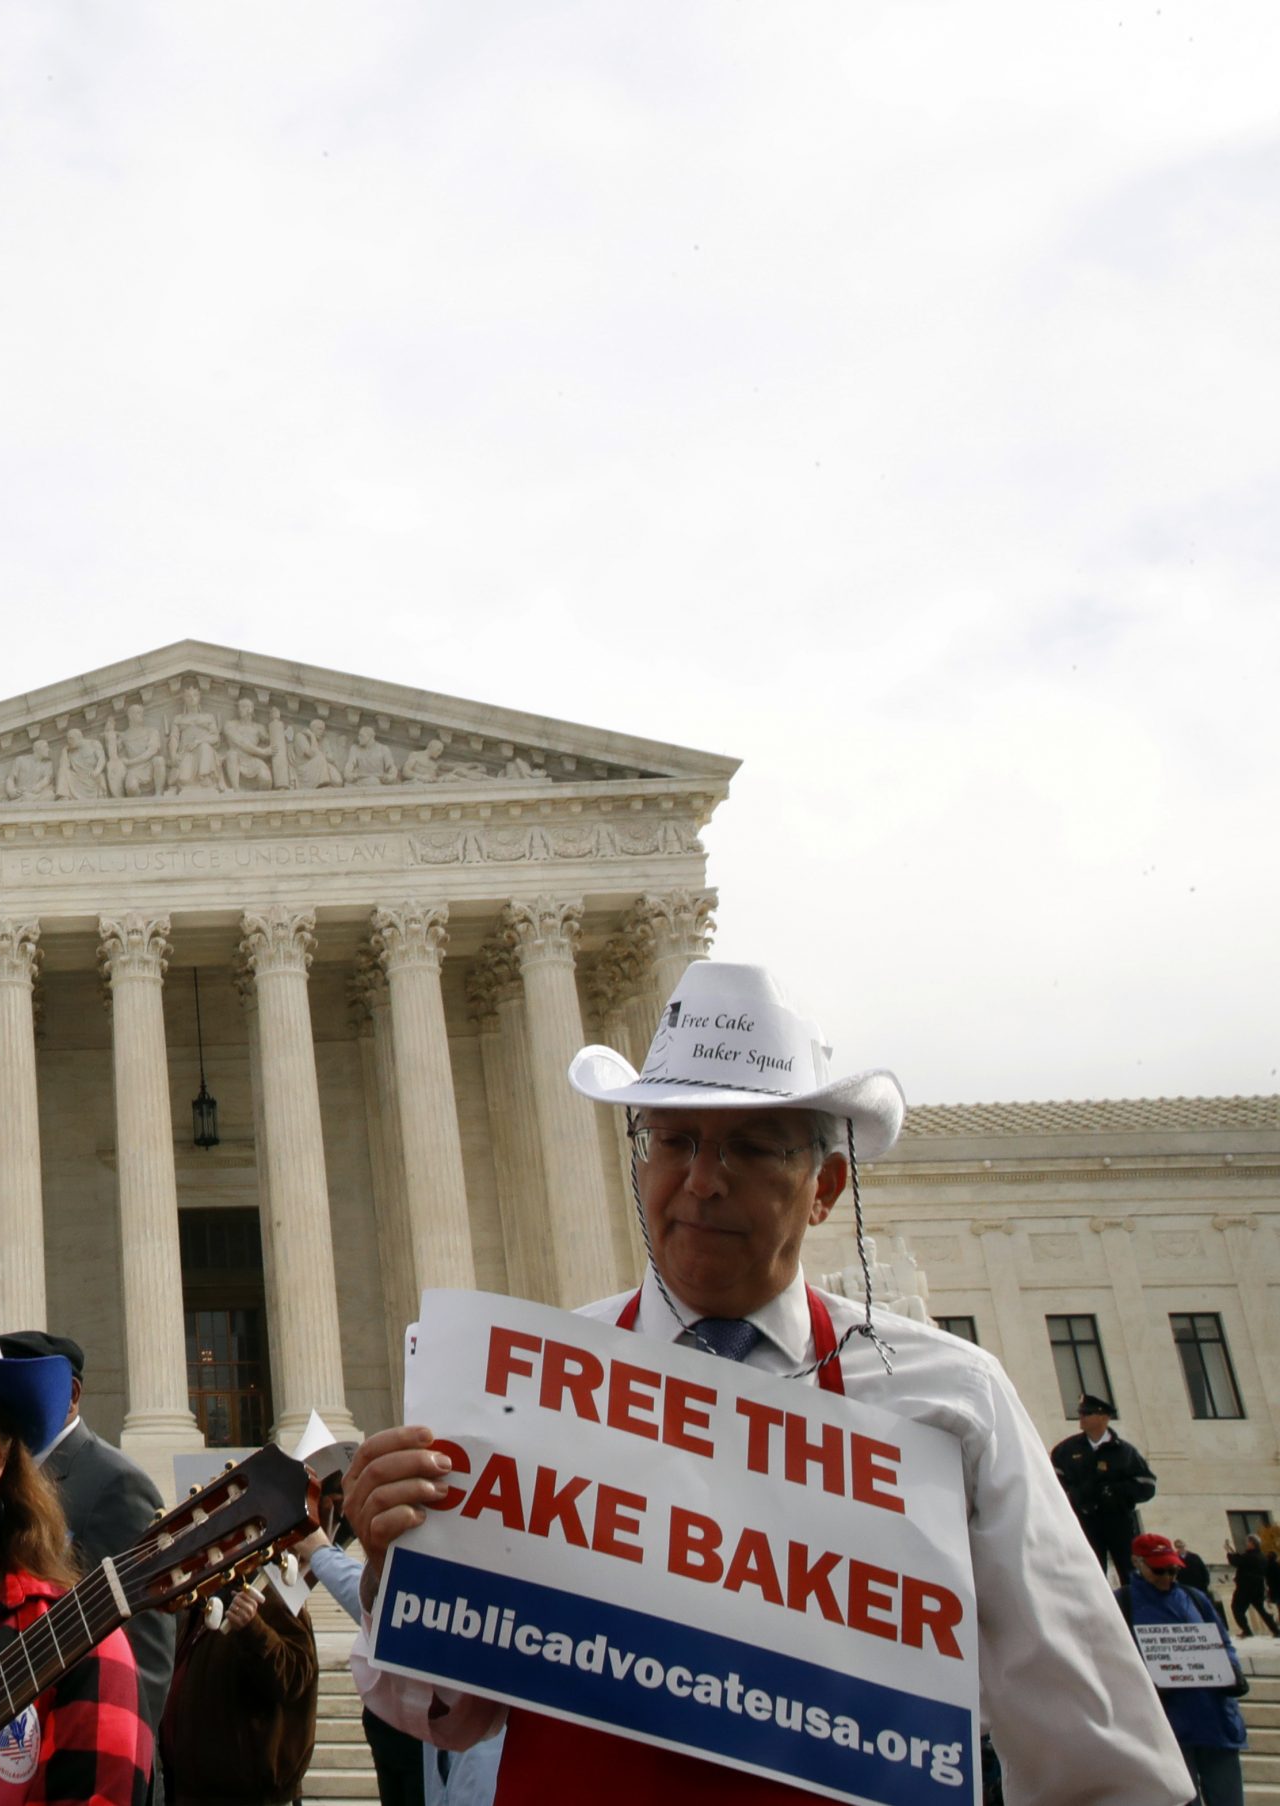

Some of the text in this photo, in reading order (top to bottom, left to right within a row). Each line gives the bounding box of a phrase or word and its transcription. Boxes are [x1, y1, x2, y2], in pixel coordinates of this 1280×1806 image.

[21, 842, 387, 877] EQUAL JUSTICE UNDER LAW
[681, 1013, 755, 1032] Free Cake
[692, 1042, 795, 1073] Baker Squad
[484, 1326, 907, 1515] FREE THE
[425, 1438, 965, 1661] CAKE BAKER
[390, 1589, 965, 1787] publicadvocateusa.org
